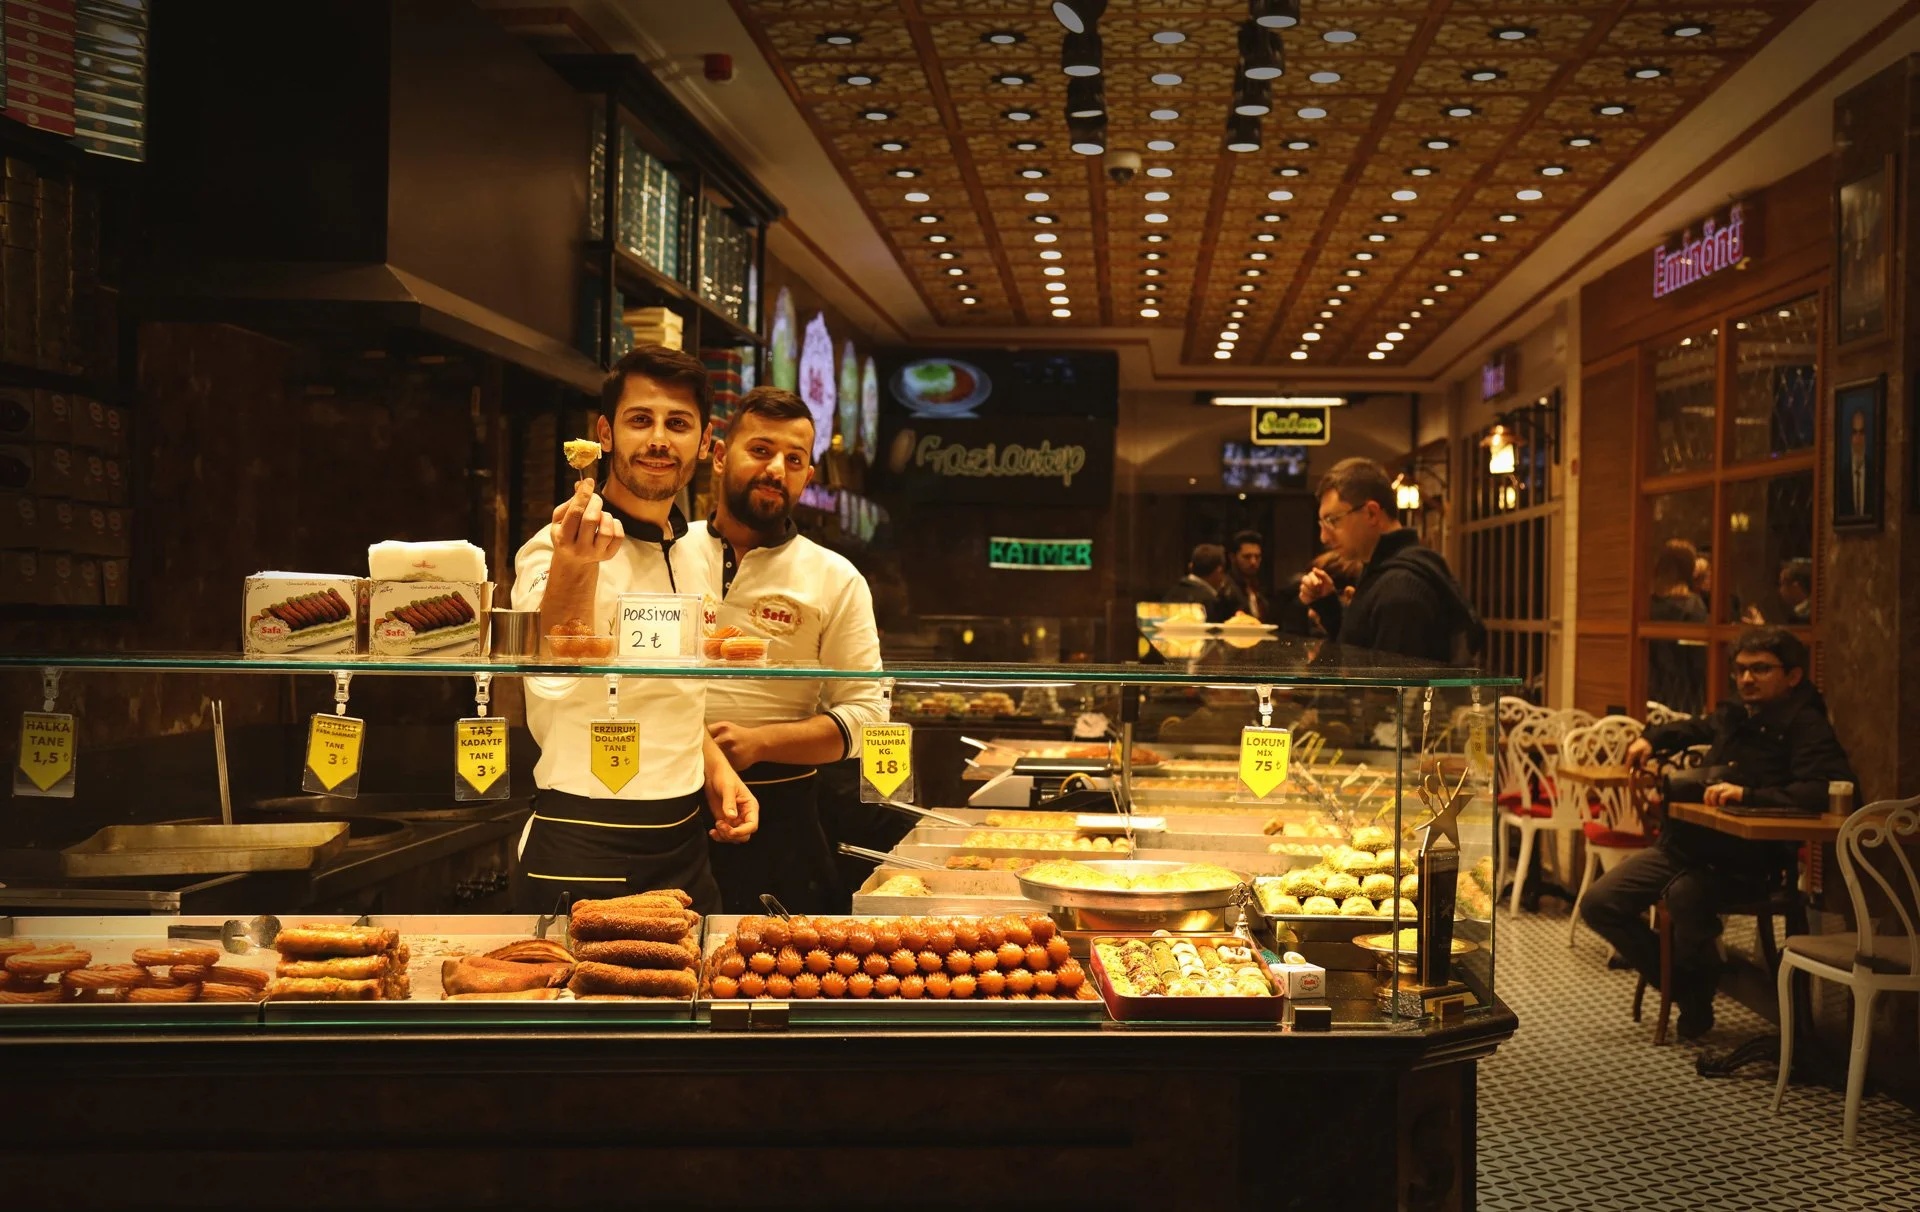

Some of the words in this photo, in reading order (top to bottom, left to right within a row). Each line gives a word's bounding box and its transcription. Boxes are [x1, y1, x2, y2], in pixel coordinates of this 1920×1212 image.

[990, 542, 1092, 566] KATMER
[623, 605, 681, 622] PORSİYON
[761, 608, 793, 624] Safa
[261, 625, 282, 636] Safa
[385, 628, 406, 638] Safa
[631, 629, 647, 649] 2
[25, 720, 71, 733] HALKA
[469, 726, 493, 738] TAŞ
[595, 735, 636, 743] DOLMASI
[865, 729, 906, 737] OSMANLI
[29, 735, 65, 748] TANE
[324, 741, 345, 750] TANE
[460, 738, 503, 747] KADAYIF
[865, 738, 907, 746] TULUMBA
[1246, 737, 1286, 748] LOKUM
[603, 744, 627, 752] TANE
[33, 751, 59, 766] 1,5
[328, 753, 338, 766] 3
[469, 752, 494, 760] TANE
[610, 755, 620, 767] 3
[476, 765, 486, 777] 3
[875, 760, 898, 775] 18
[1255, 760, 1273, 772] 75
